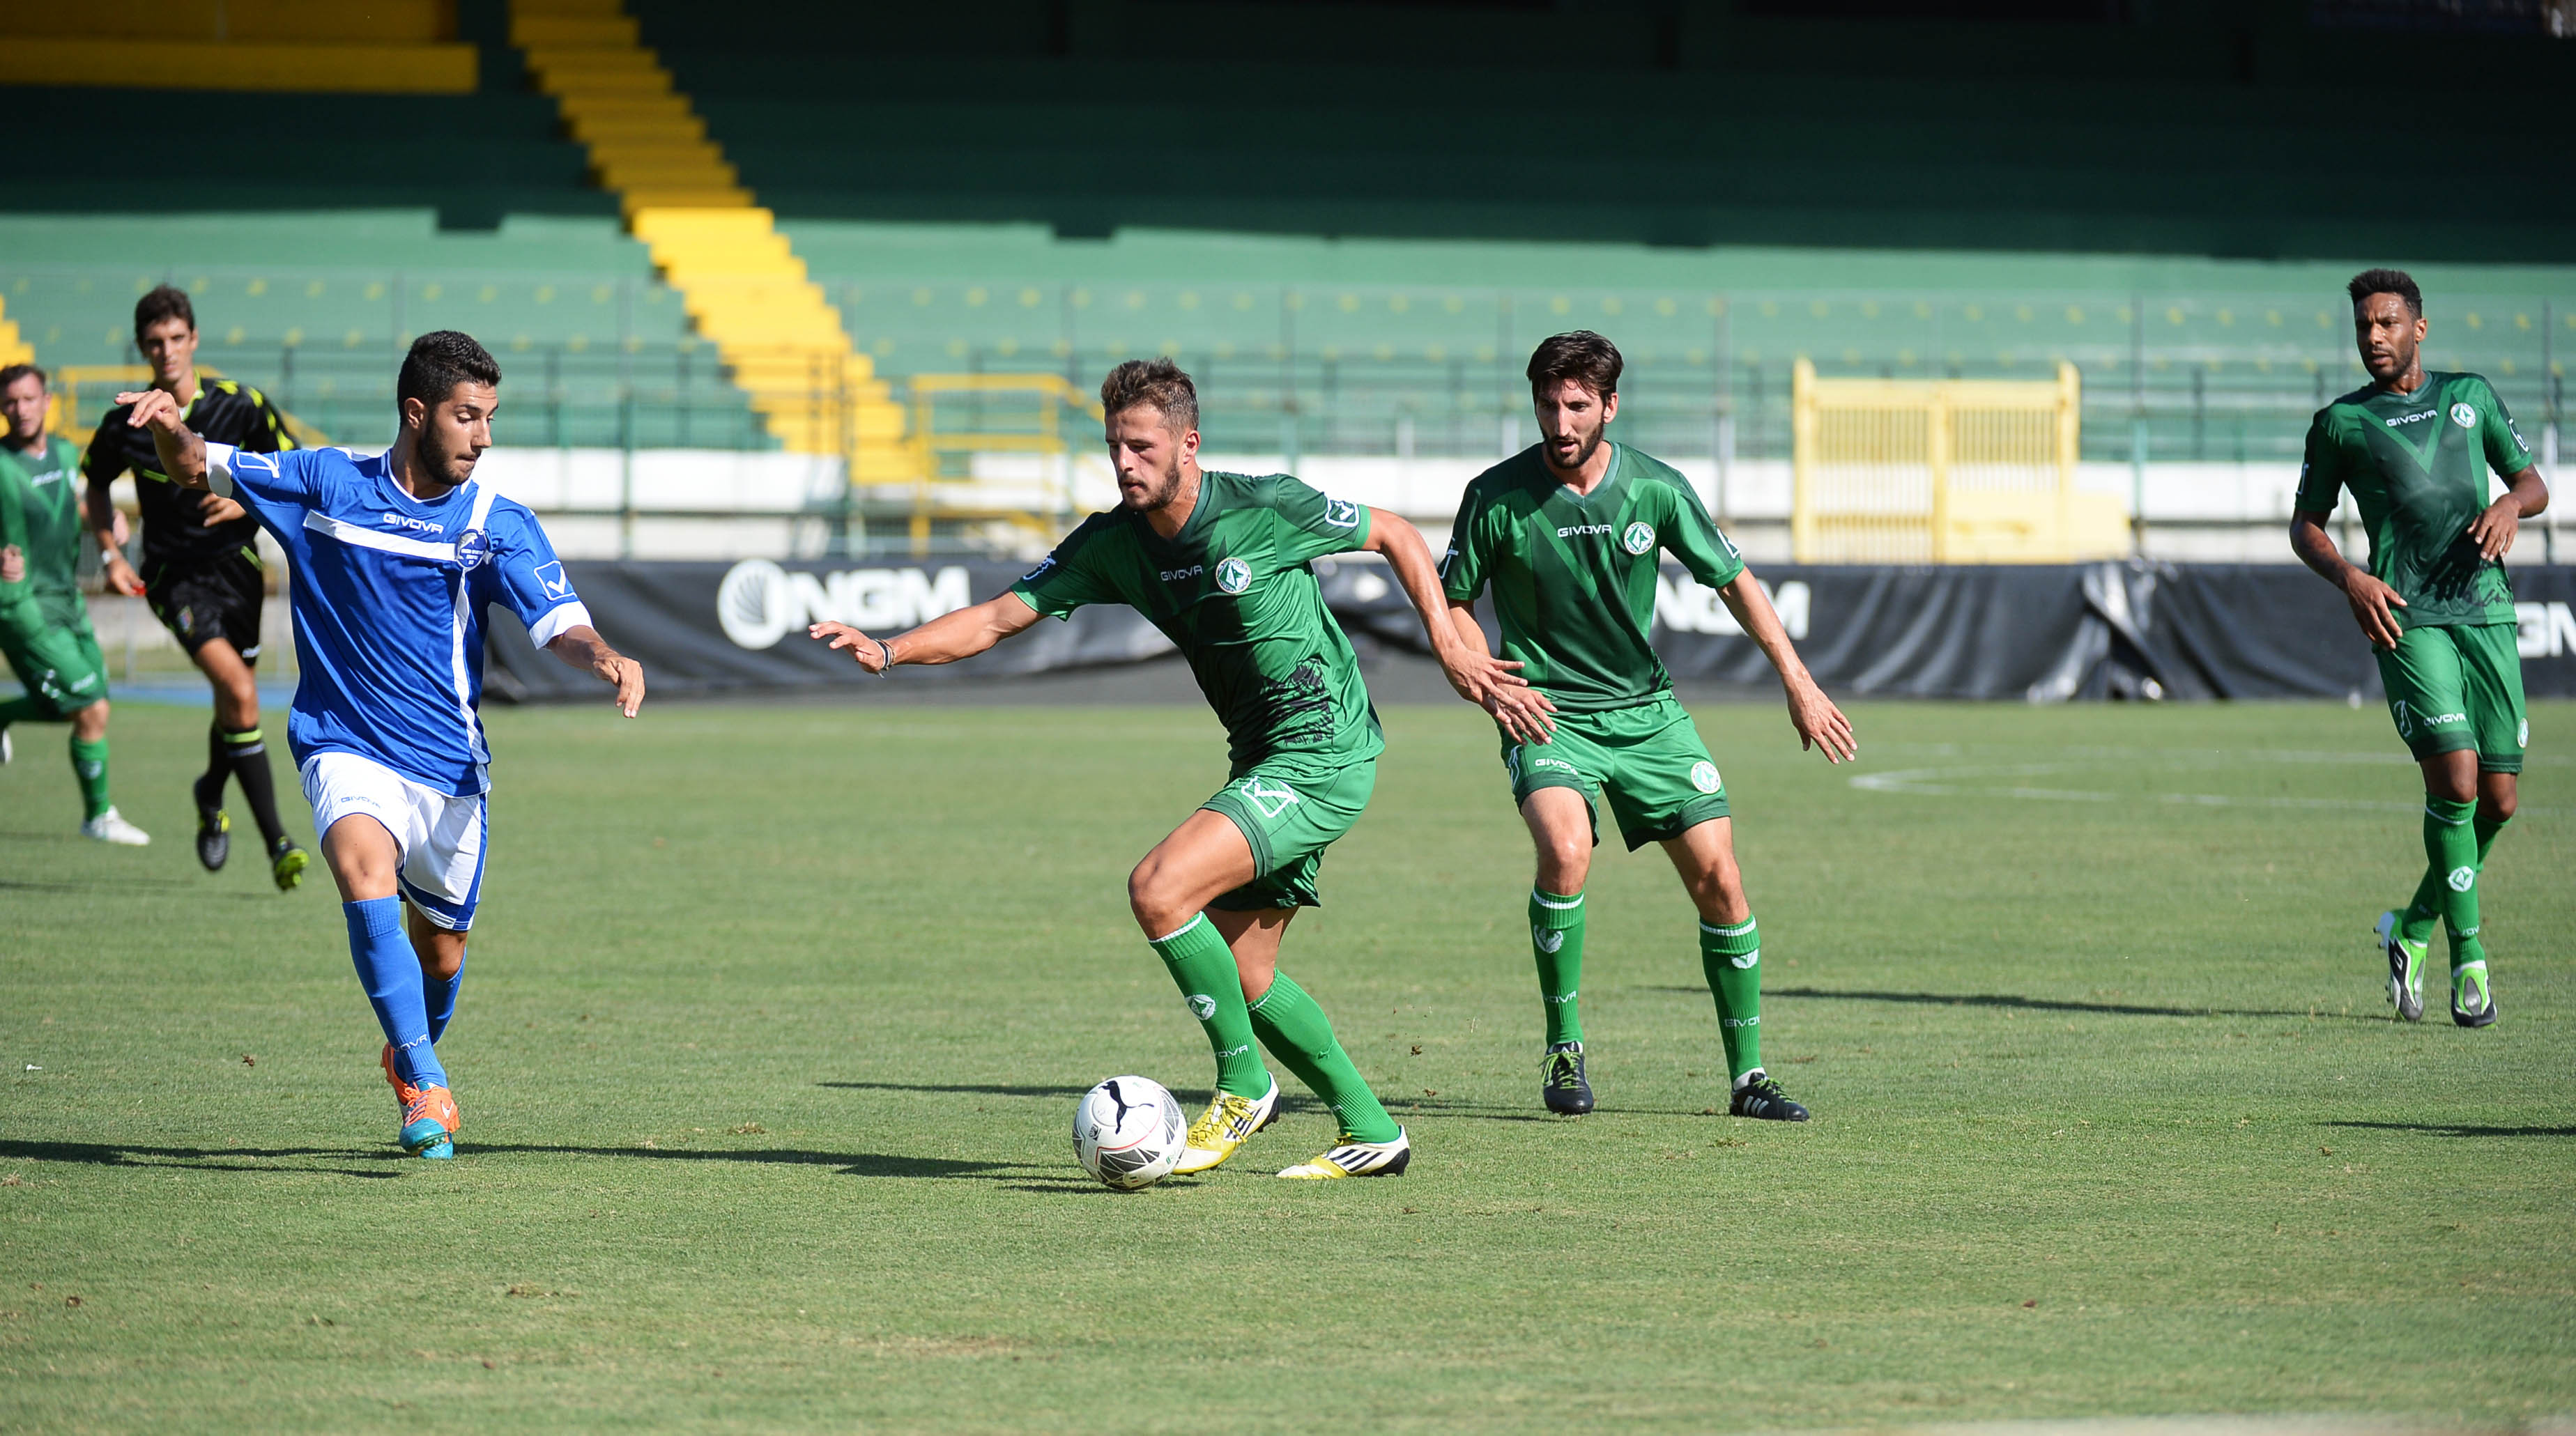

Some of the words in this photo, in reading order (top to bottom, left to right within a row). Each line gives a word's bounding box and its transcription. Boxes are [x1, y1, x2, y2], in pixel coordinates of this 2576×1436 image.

[2386, 410, 2438, 426] GIVOVA
[383, 513, 444, 534] GIVOVA
[1557, 524, 1612, 538] GIVOVA
[1160, 564, 1203, 582] GIVOVA
[786, 565, 971, 633] NGM
